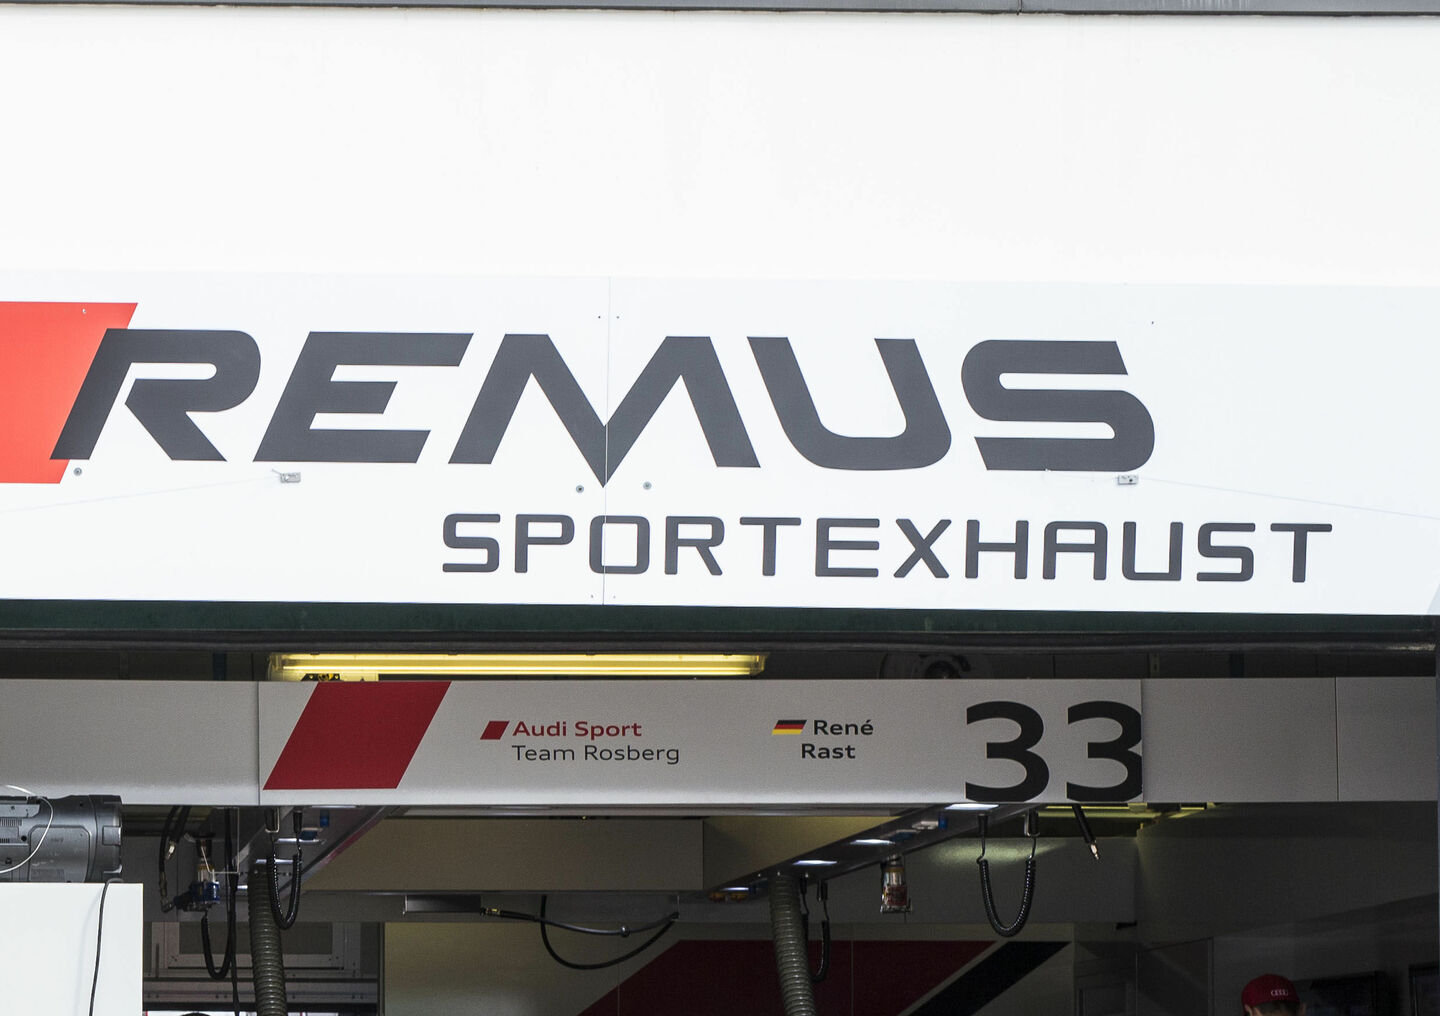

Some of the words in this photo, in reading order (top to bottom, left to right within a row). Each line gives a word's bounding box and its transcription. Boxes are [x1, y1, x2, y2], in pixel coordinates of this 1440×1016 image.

[49, 327, 1156, 488] REMUS
[441, 512, 1333, 584] SPORTEXHAUST
[511, 720, 567, 737] Audi
[574, 720, 643, 740] Sport
[812, 718, 874, 736] René
[511, 744, 576, 762] Team
[583, 744, 681, 765] Rosberg
[801, 742, 857, 760] Rast
[965, 700, 1143, 802] 33
